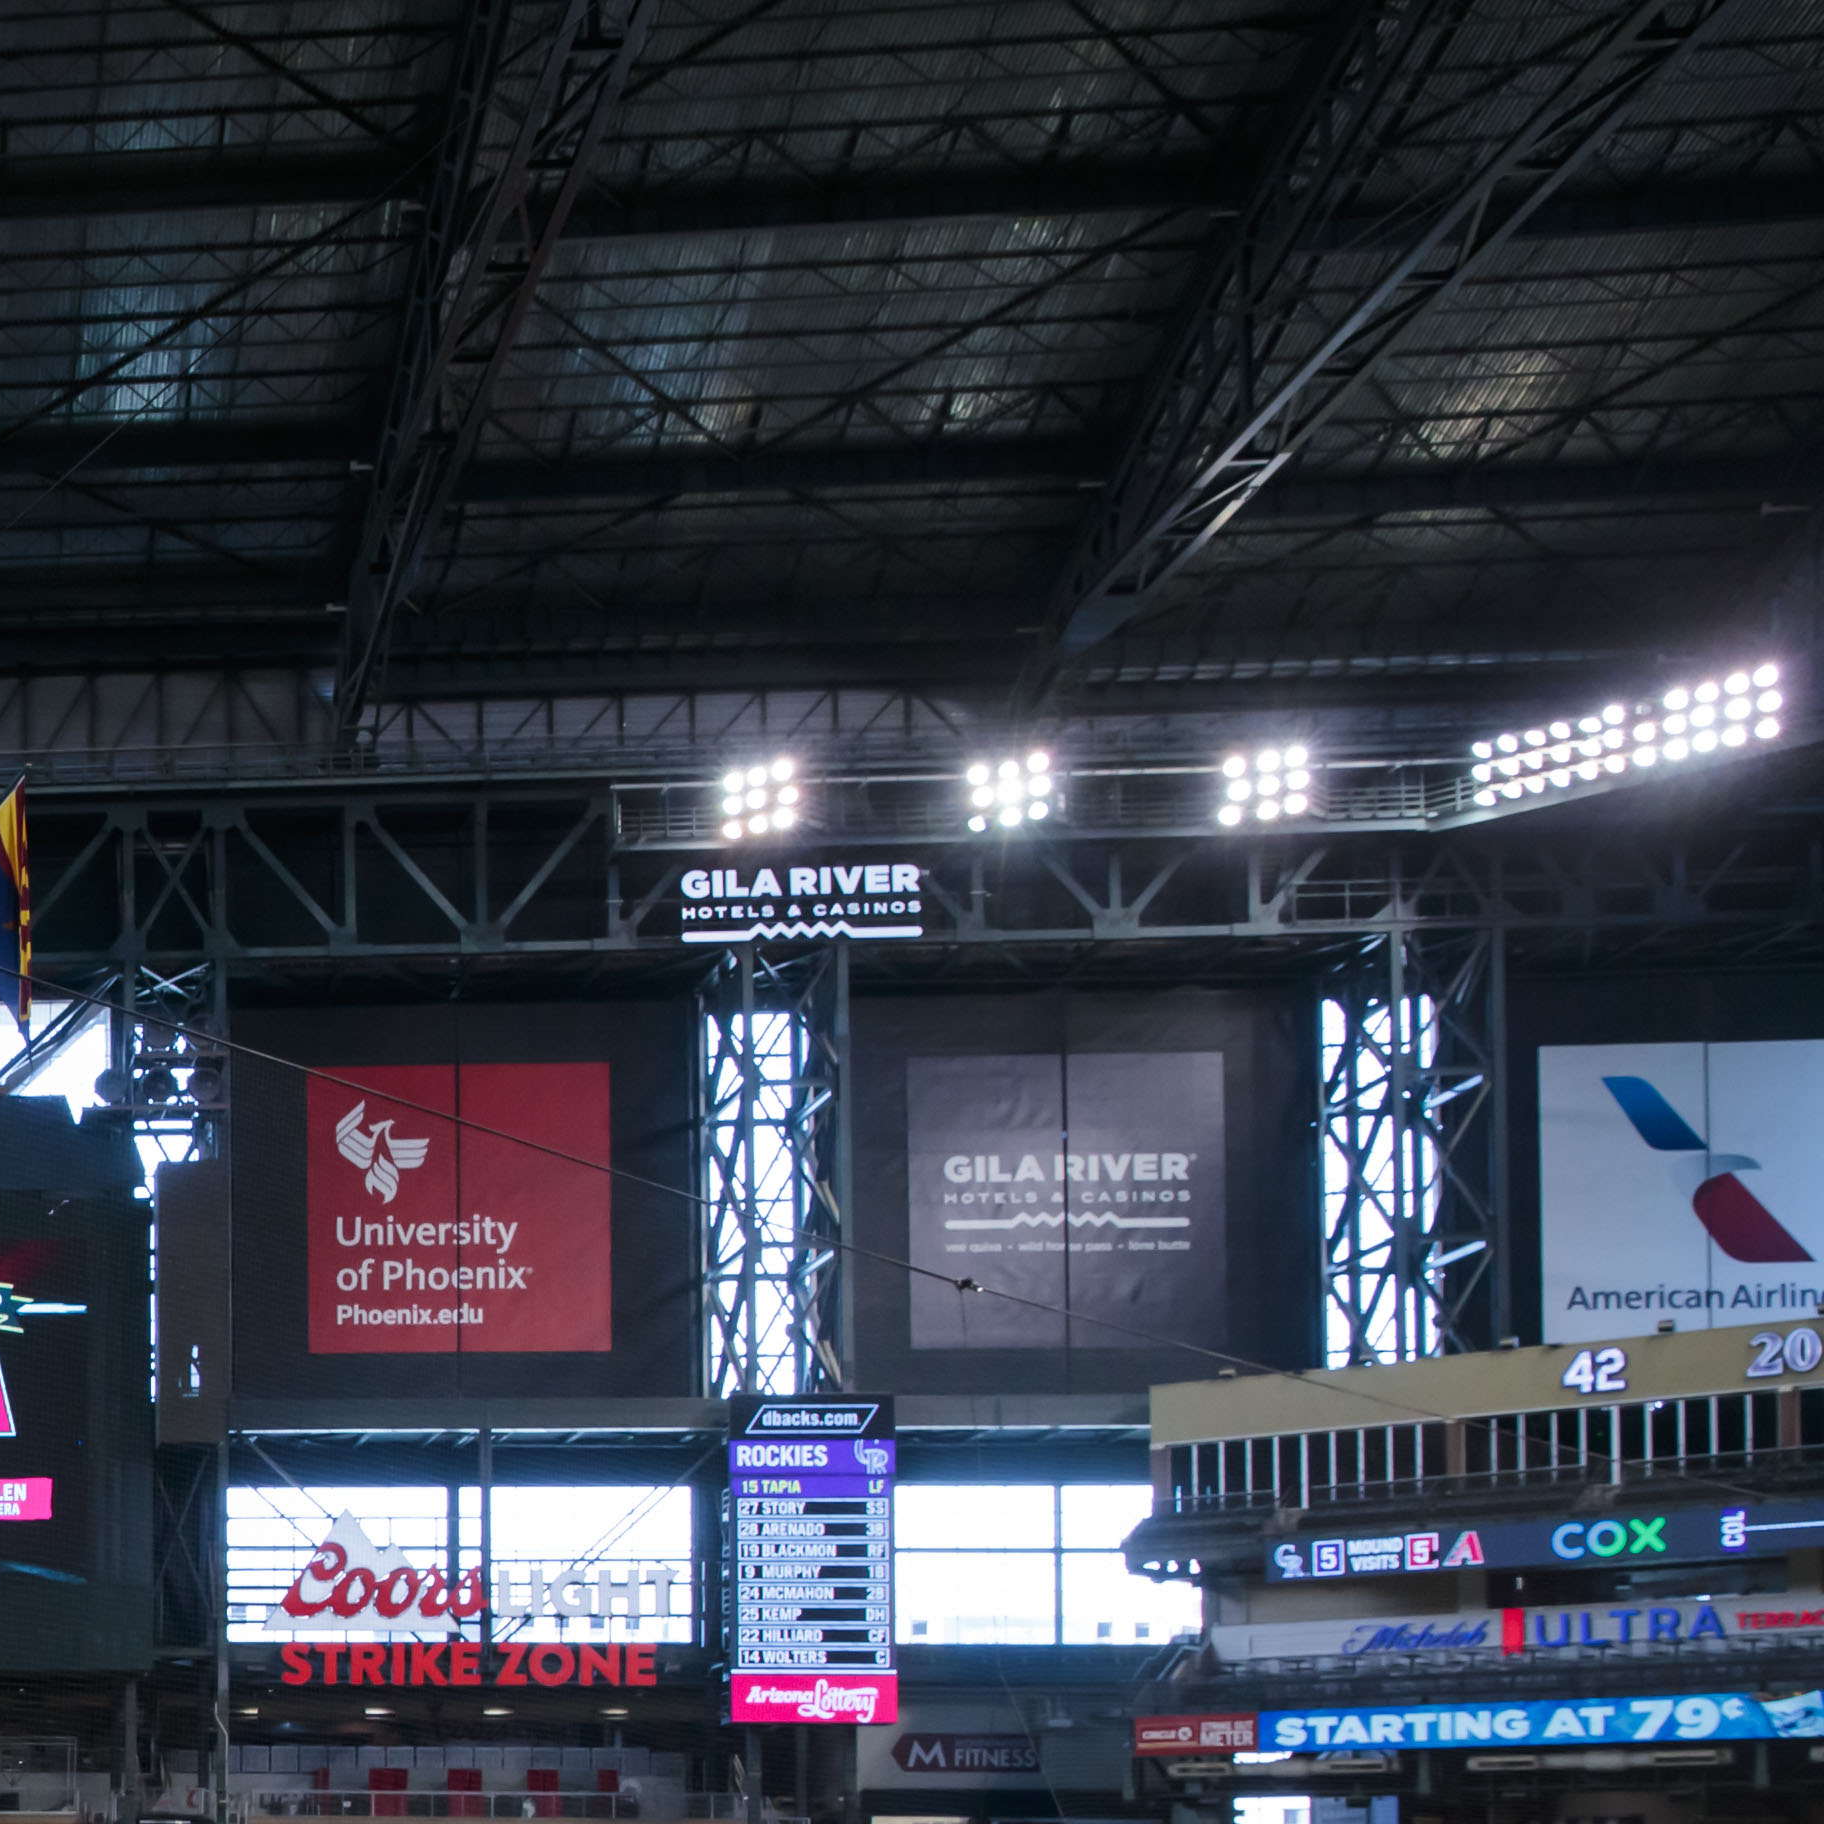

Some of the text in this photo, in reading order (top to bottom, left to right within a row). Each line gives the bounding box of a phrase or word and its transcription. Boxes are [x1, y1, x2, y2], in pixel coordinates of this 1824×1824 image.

[681, 864, 920, 899] GILA RIVER
[682, 900, 922, 920] HOTELS CASINOS
[944, 1152, 1190, 1183] GILA RIVER
[336, 1214, 518, 1254] University
[336, 1258, 527, 1291] of Phoenix
[1567, 1284, 1723, 1310] American
[337, 1302, 483, 1325] Phoenix.edu
[1562, 1327, 1822, 1393] 42 20
[736, 1445, 829, 1467] ROCKIES
[761, 1480, 801, 1494] TAPIA
[761, 1501, 806, 1515] STORY
[760, 1523, 825, 1536] ARENADO
[1551, 1510, 1747, 1560] COX COL
[761, 1544, 837, 1557] BLACKMON
[1347, 1537, 1404, 1556] MOUND
[761, 1565, 822, 1579] MURPHY
[1351, 1553, 1400, 1571] VISITS
[282, 1542, 679, 1619] Coors LIGHT
[761, 1587, 835, 1600] MCMAHON
[761, 1608, 802, 1621] KEMP
[761, 1629, 824, 1642] HILLIARD
[1535, 1604, 1725, 1648] ULTRA
[281, 1642, 657, 1687] STRIKE ZONE
[761, 1651, 828, 1664] WOLTERS
[745, 1679, 879, 1723] Arizona Lottery
[1273, 1705, 1615, 1747] STARTING AT
[1200, 1731, 1254, 1746] METER
[954, 1748, 1038, 1768] FITNESS
